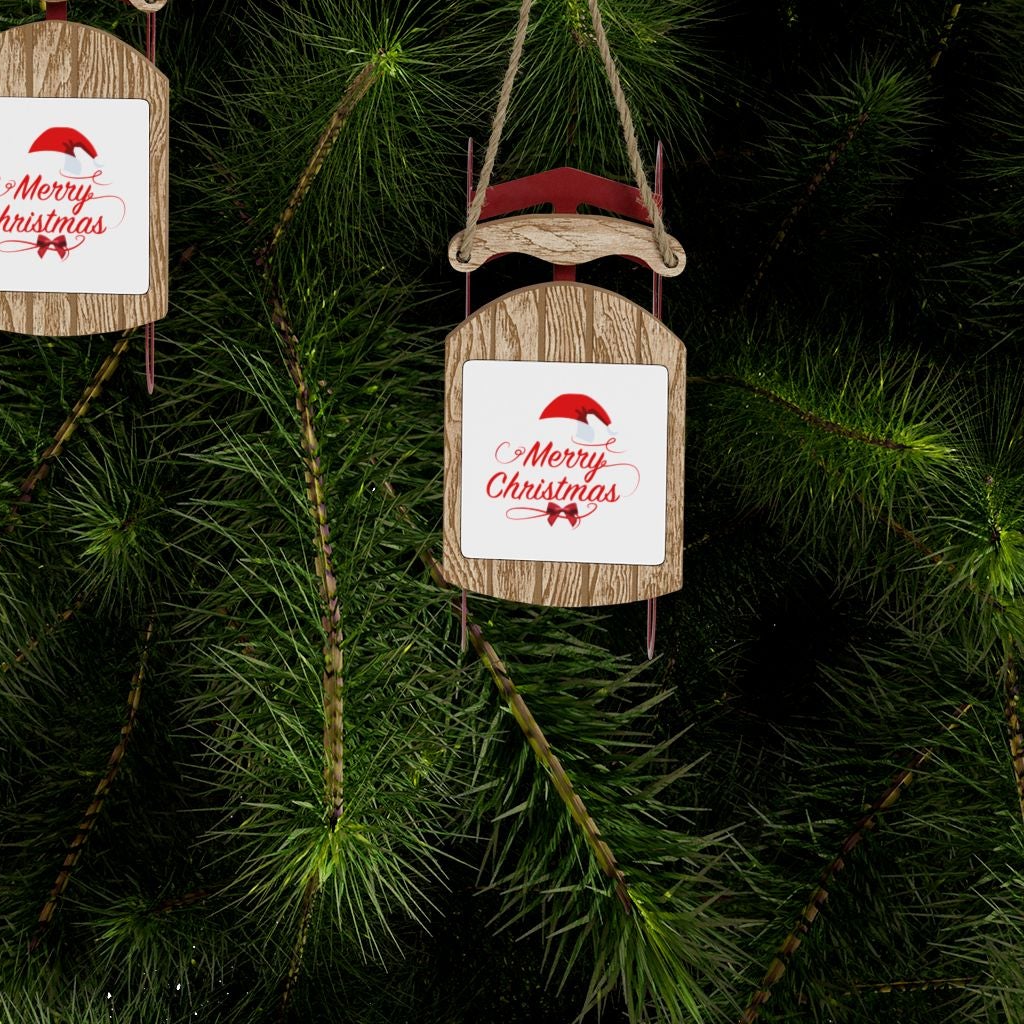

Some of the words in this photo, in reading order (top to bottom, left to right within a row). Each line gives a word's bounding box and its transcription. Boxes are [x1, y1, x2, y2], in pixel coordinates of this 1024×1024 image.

[13, 174, 93, 215] Merry
[522, 440, 606, 483] Merry
[485, 470, 620, 503] Christmas
